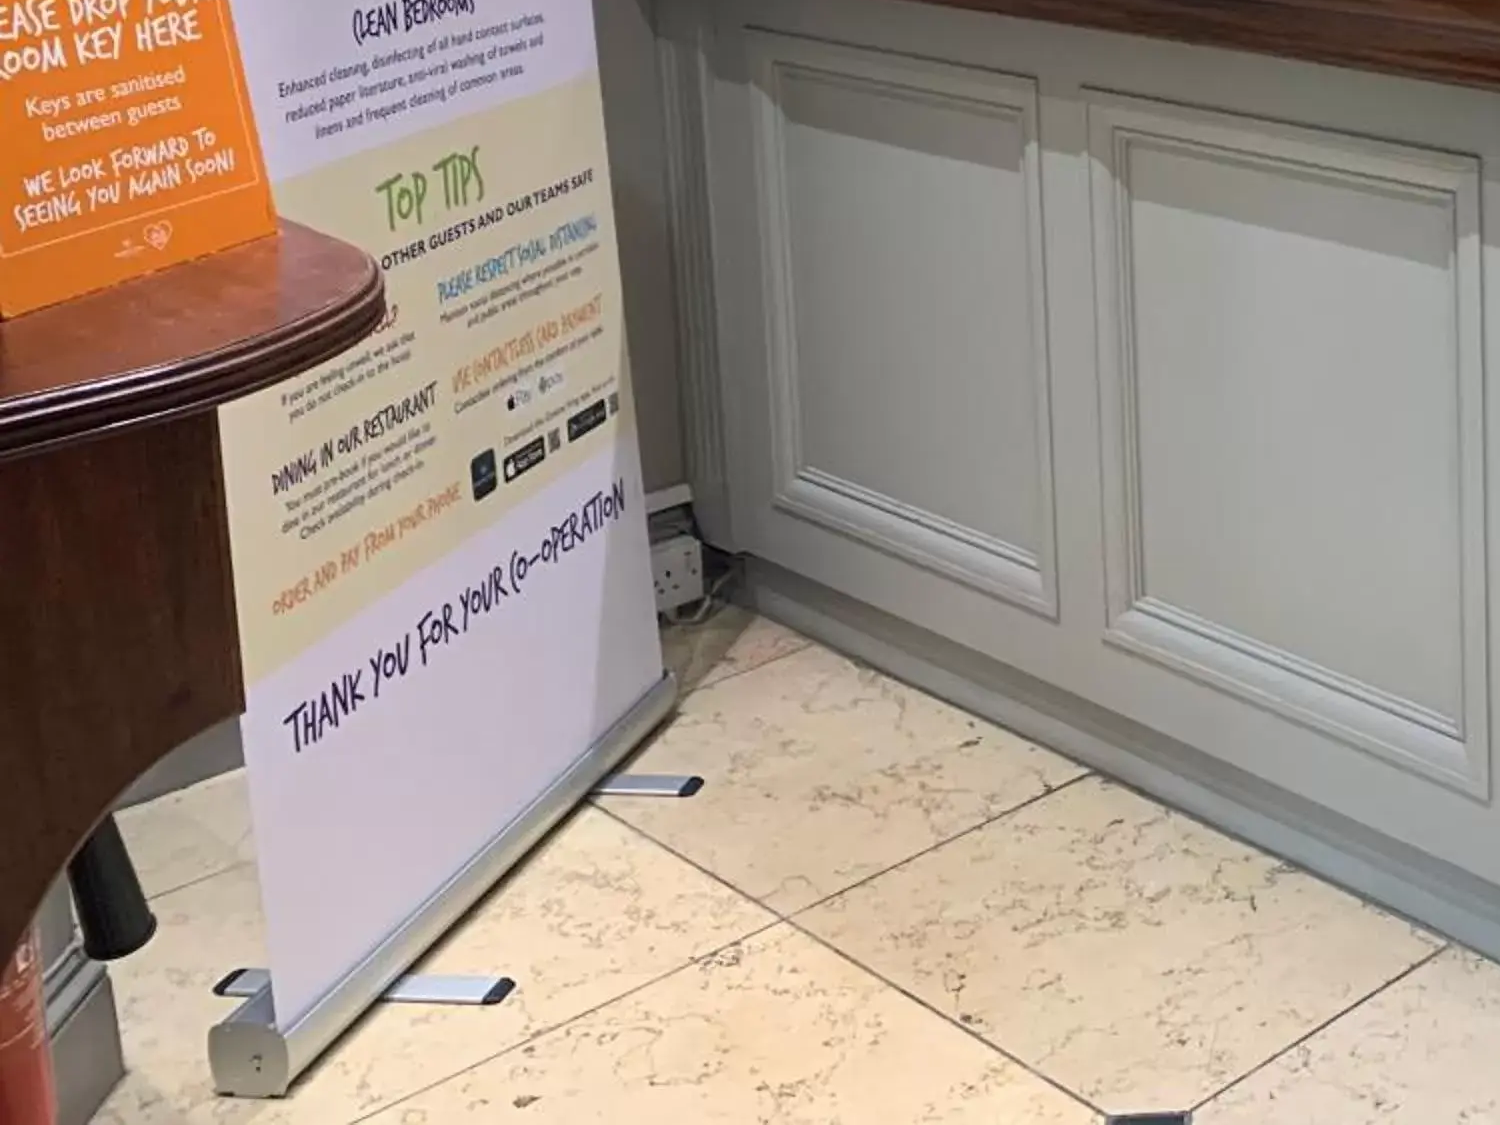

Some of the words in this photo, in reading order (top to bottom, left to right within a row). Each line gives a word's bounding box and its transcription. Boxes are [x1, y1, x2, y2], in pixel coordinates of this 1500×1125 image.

[0, 37, 67, 79] OOM
[74, 22, 122, 65] KEY
[136, 10, 202, 51] HERE
[352, 2, 398, 46] CLEAN
[26, 94, 71, 117] Keys
[76, 88, 105, 106] are
[112, 64, 186, 99] sanitised
[43, 110, 121, 142] between
[127, 95, 181, 126] guests
[279, 71, 326, 97] Enhanced
[286, 98, 325, 122] reduced
[328, 92, 355, 112] paper
[14, 190, 81, 233] SEEING
[86, 182, 120, 211] YOU
[129, 163, 181, 199] AGAIN
[187, 148, 234, 182] SOON!
[24, 170, 55, 198] WE
[58, 158, 107, 188] LOOK
[110, 136, 189, 175] FORWARD
[192, 127, 216, 151] TO
[375, 172, 427, 231] TOP
[432, 144, 485, 210] TIPS
[381, 240, 426, 270] OTHER
[428, 219, 474, 249] GUESTS
[477, 208, 502, 229] AND
[507, 196, 533, 216] OUR
[534, 180, 568, 205] TEAMS
[571, 168, 593, 189] SAFE
[271, 450, 317, 495] DINING
[319, 437, 334, 469] IN
[337, 422, 362, 456] OUR
[363, 380, 438, 444] RESTAURANT
[271, 577, 312, 617] ORDER
[313, 564, 339, 596] AND
[364, 530, 395, 567] FROM
[283, 668, 365, 753] THANK
[369, 633, 411, 697] YOU
[417, 602, 459, 666] FOR
[459, 565, 509, 632] YOUR
[510, 478, 625, 594] CO-OPERATION
